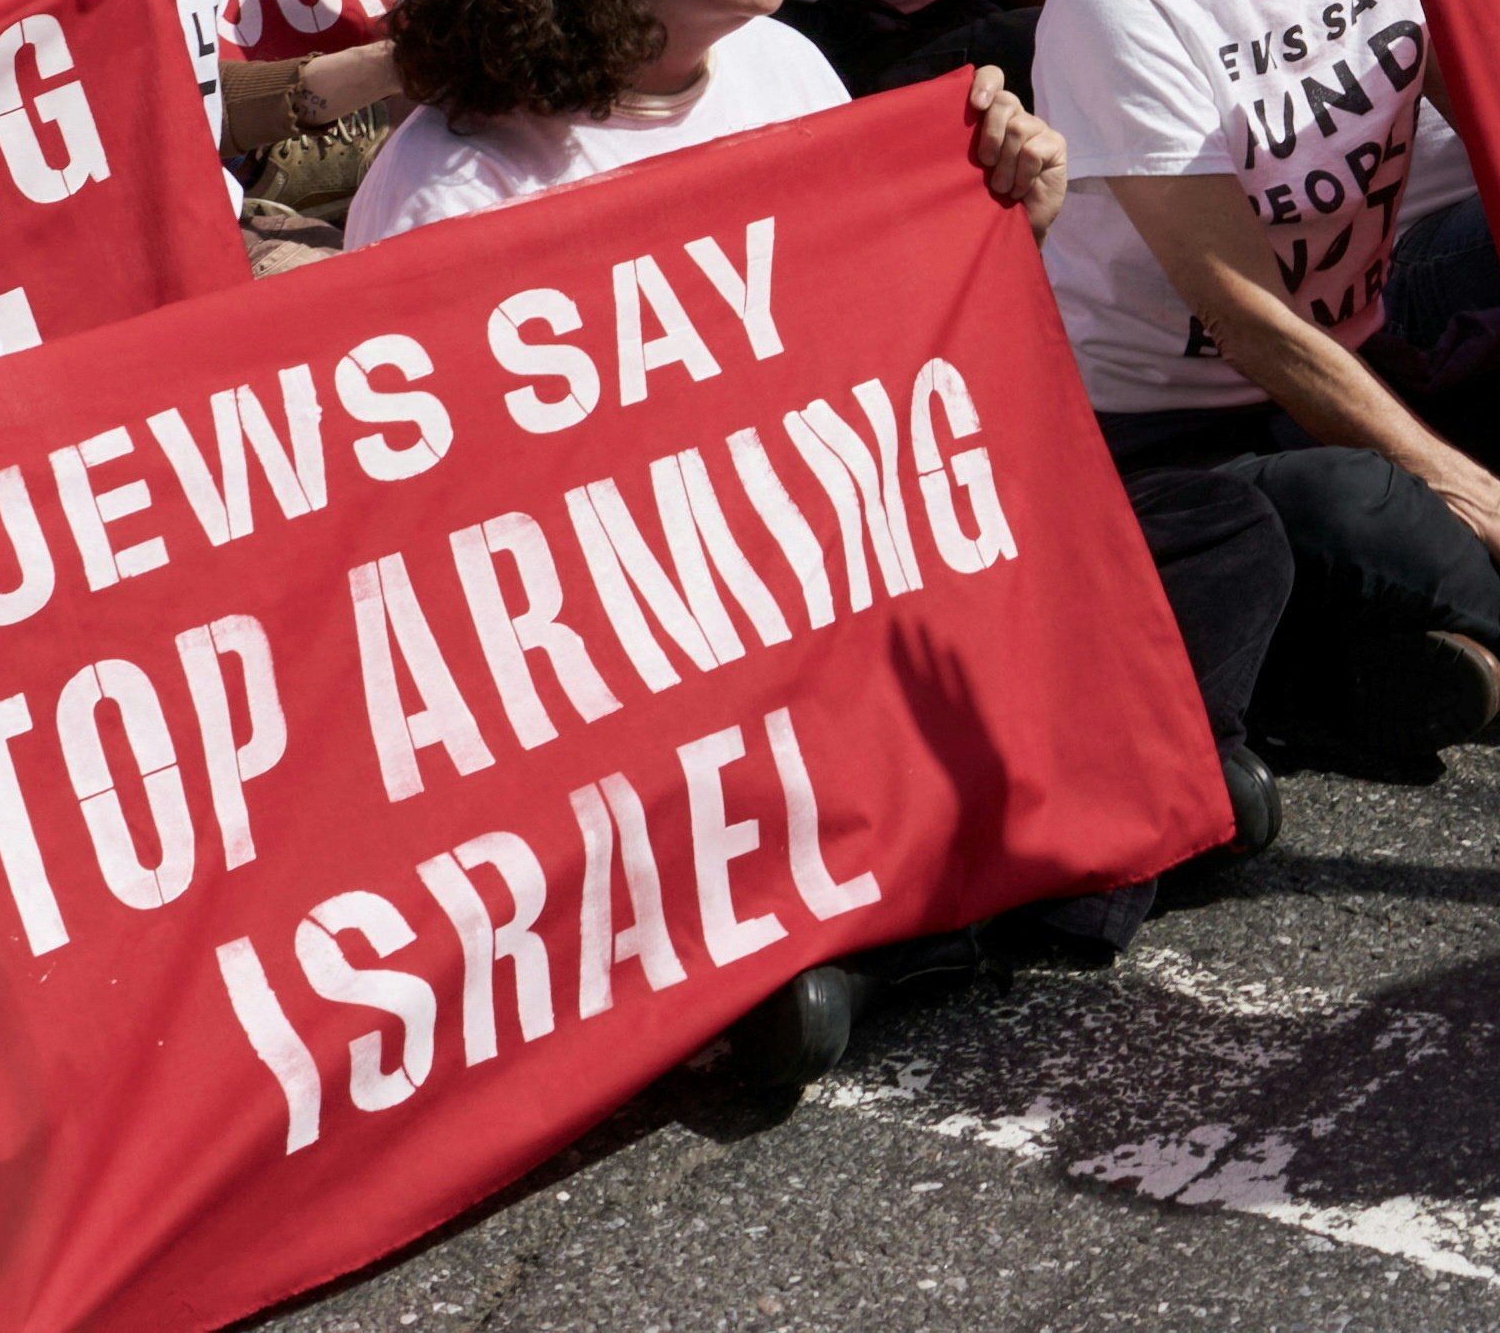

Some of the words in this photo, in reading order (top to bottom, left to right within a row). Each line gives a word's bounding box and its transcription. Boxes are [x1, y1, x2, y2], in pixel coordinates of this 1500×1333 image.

[1244, 20, 1425, 172] UND
[485, 213, 783, 438] SAY
[348, 355, 1018, 803] ARMING
[213, 704, 883, 1156] ISRAEL
